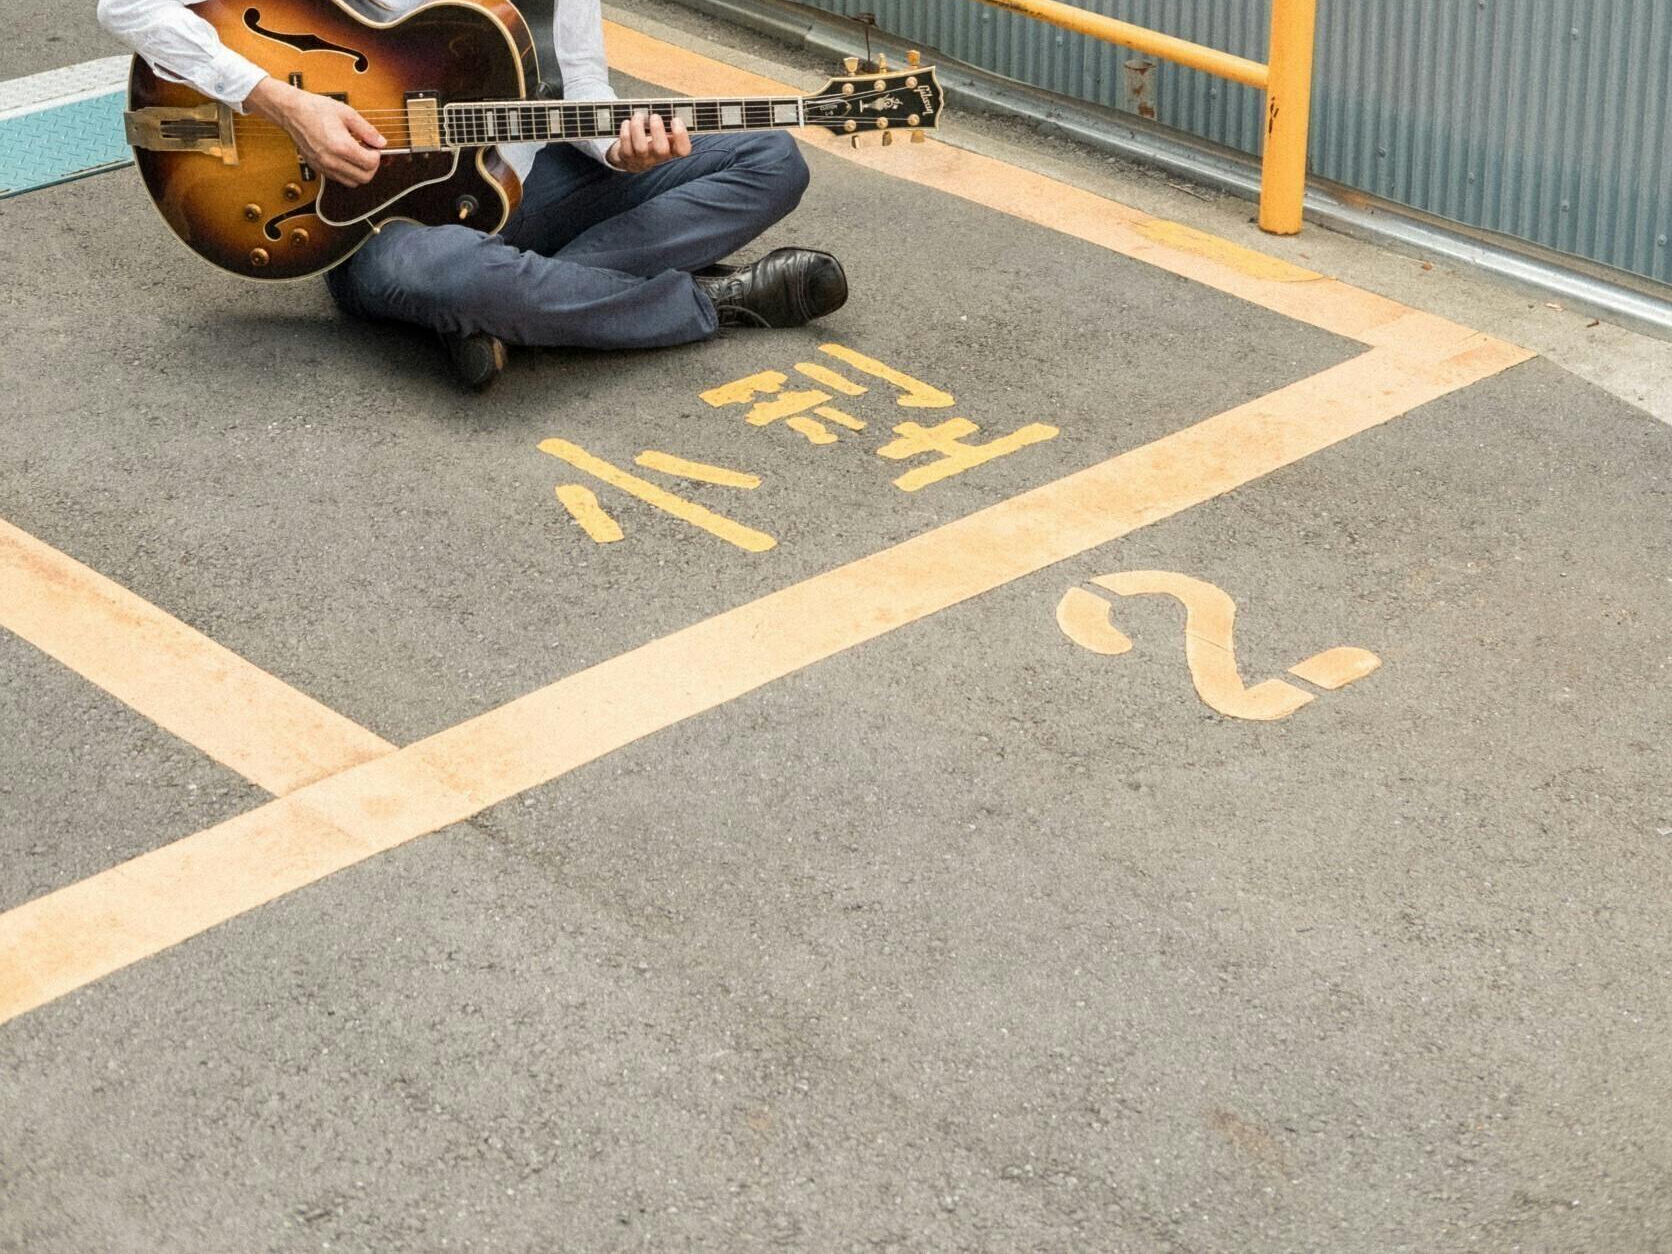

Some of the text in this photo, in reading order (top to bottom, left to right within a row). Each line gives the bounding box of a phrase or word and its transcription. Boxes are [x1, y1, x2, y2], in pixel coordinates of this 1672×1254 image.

[913, 85, 934, 116] Gibson
[537, 343, 1059, 553] 小型
[1056, 570, 1382, 721] 2
